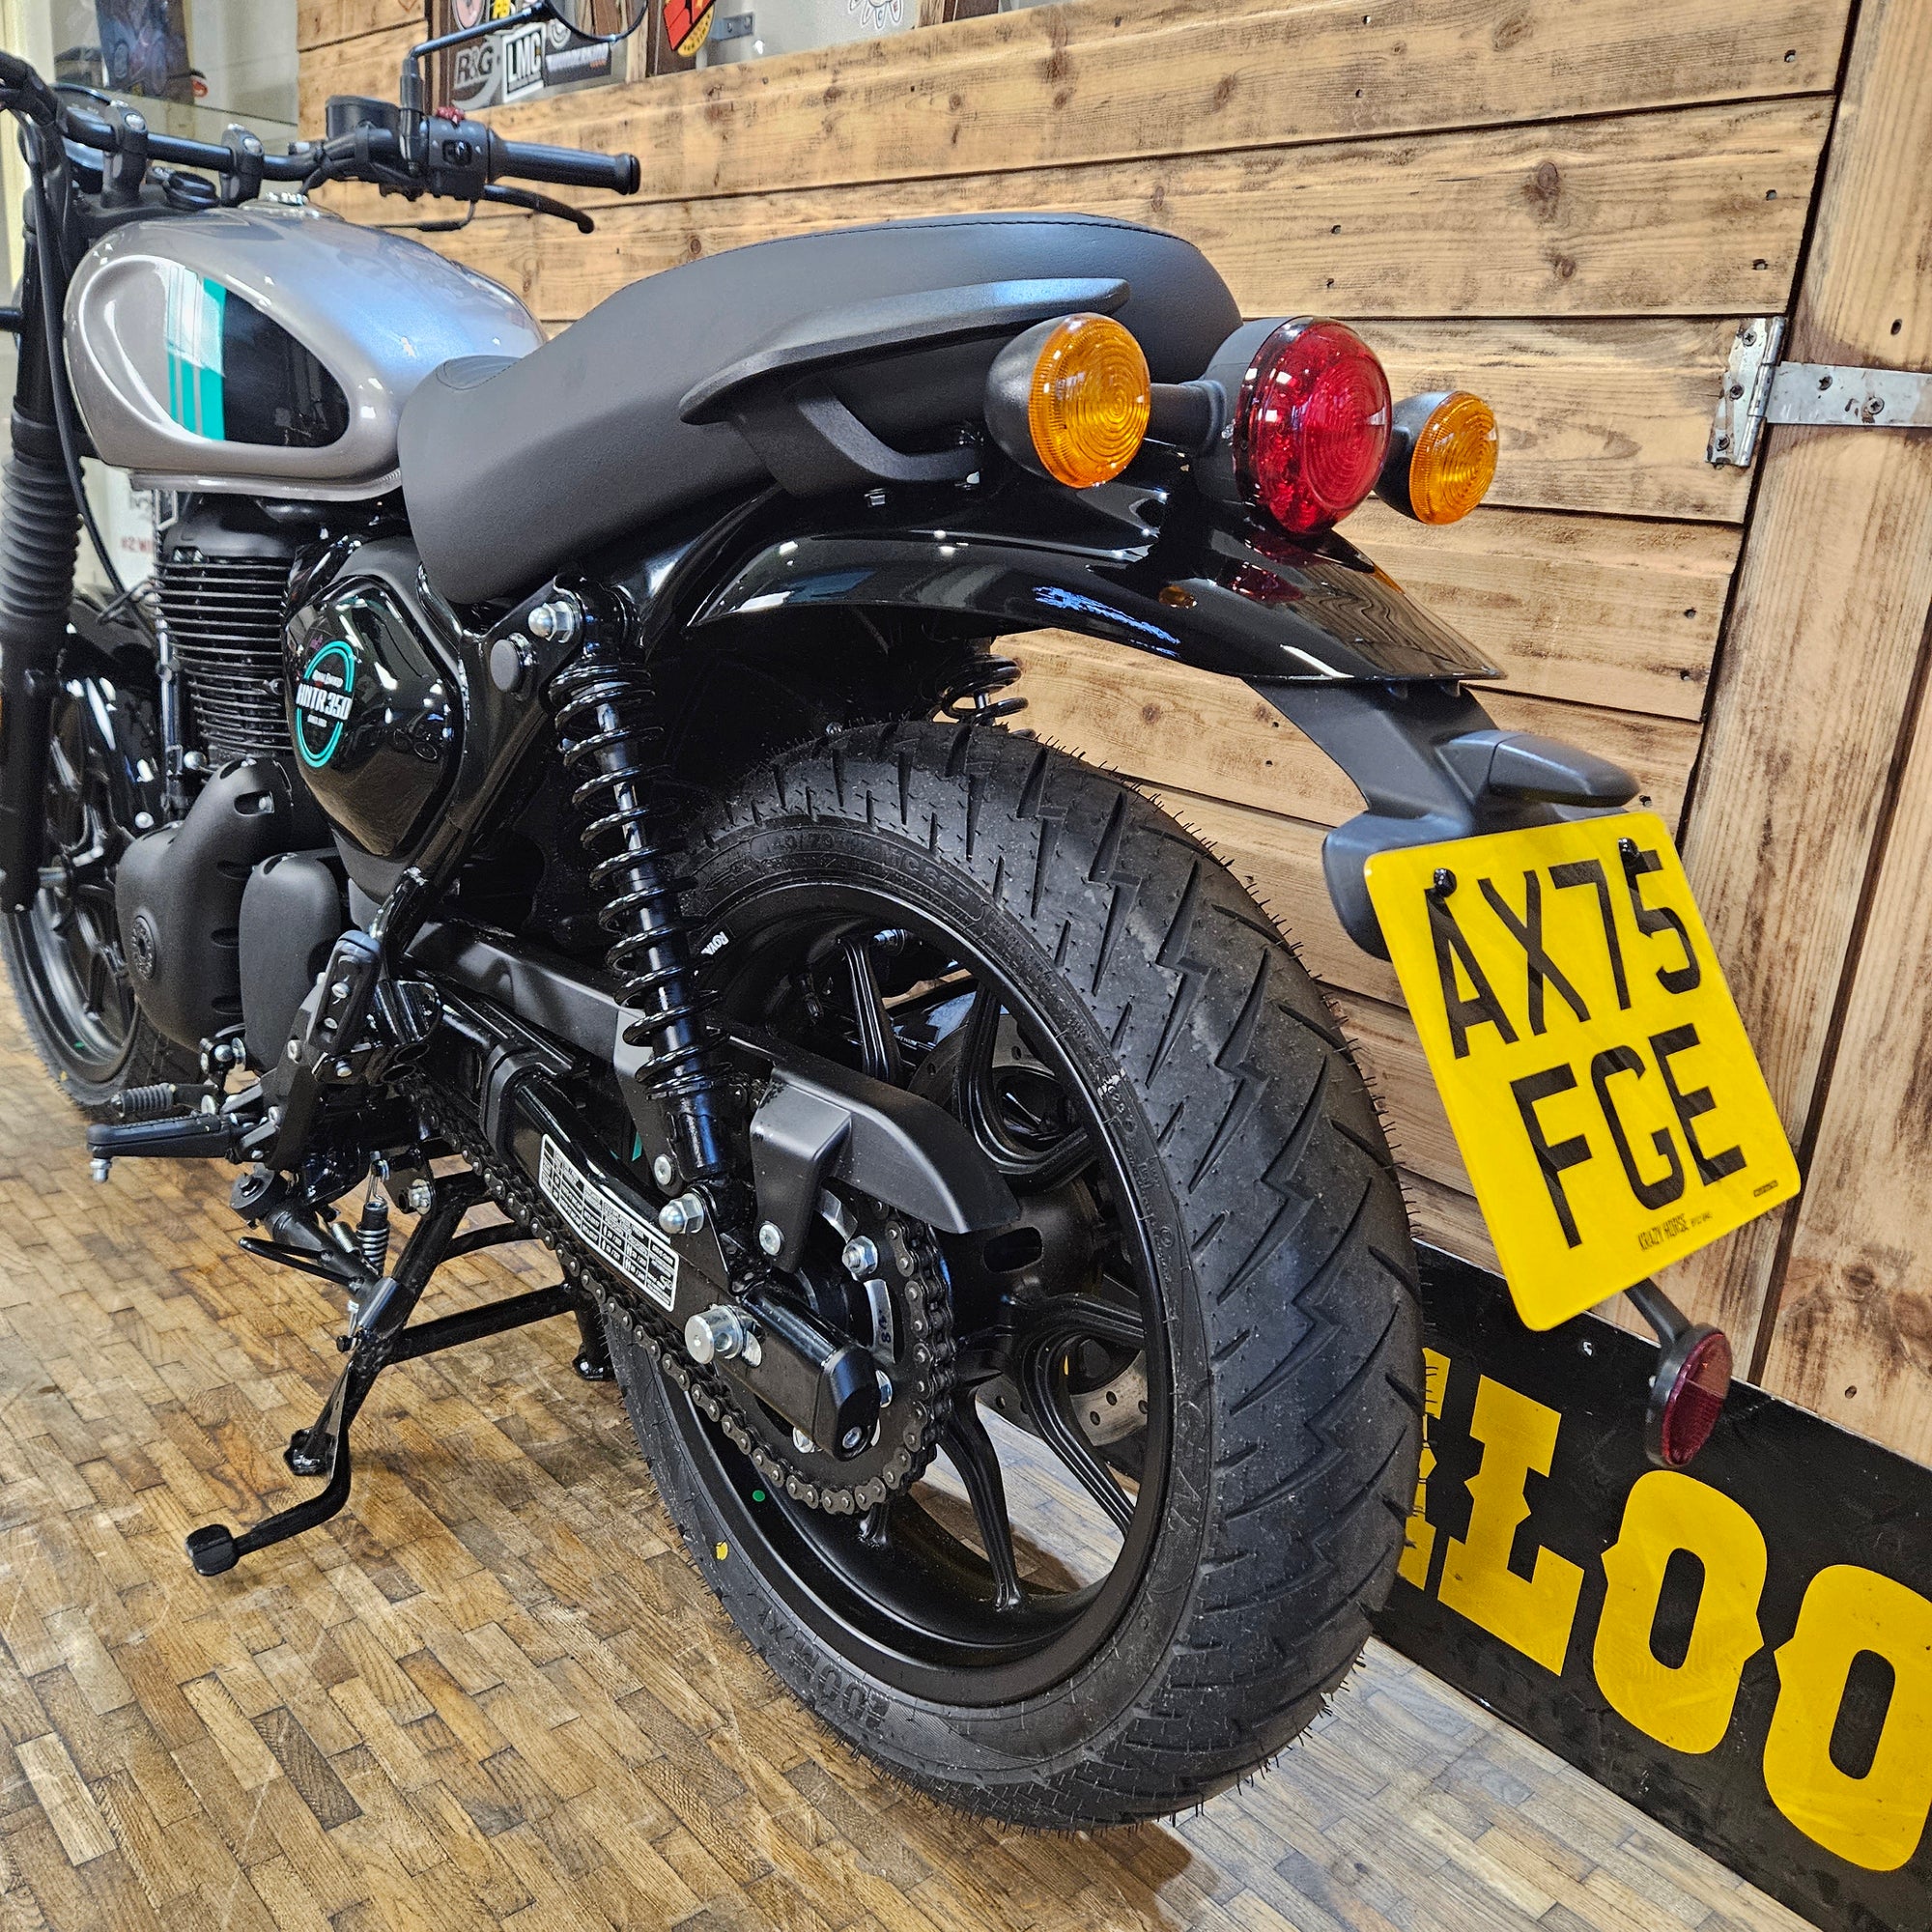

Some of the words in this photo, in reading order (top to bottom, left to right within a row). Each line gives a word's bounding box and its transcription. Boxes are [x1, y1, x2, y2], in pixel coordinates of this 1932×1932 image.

[457, 45, 494, 85] R&G
[506, 32, 542, 83] LMC
[1425, 849, 1700, 1059] AX75
[1510, 1023, 1747, 1249] FGE
[1397, 1347, 1932, 1871] LOO
